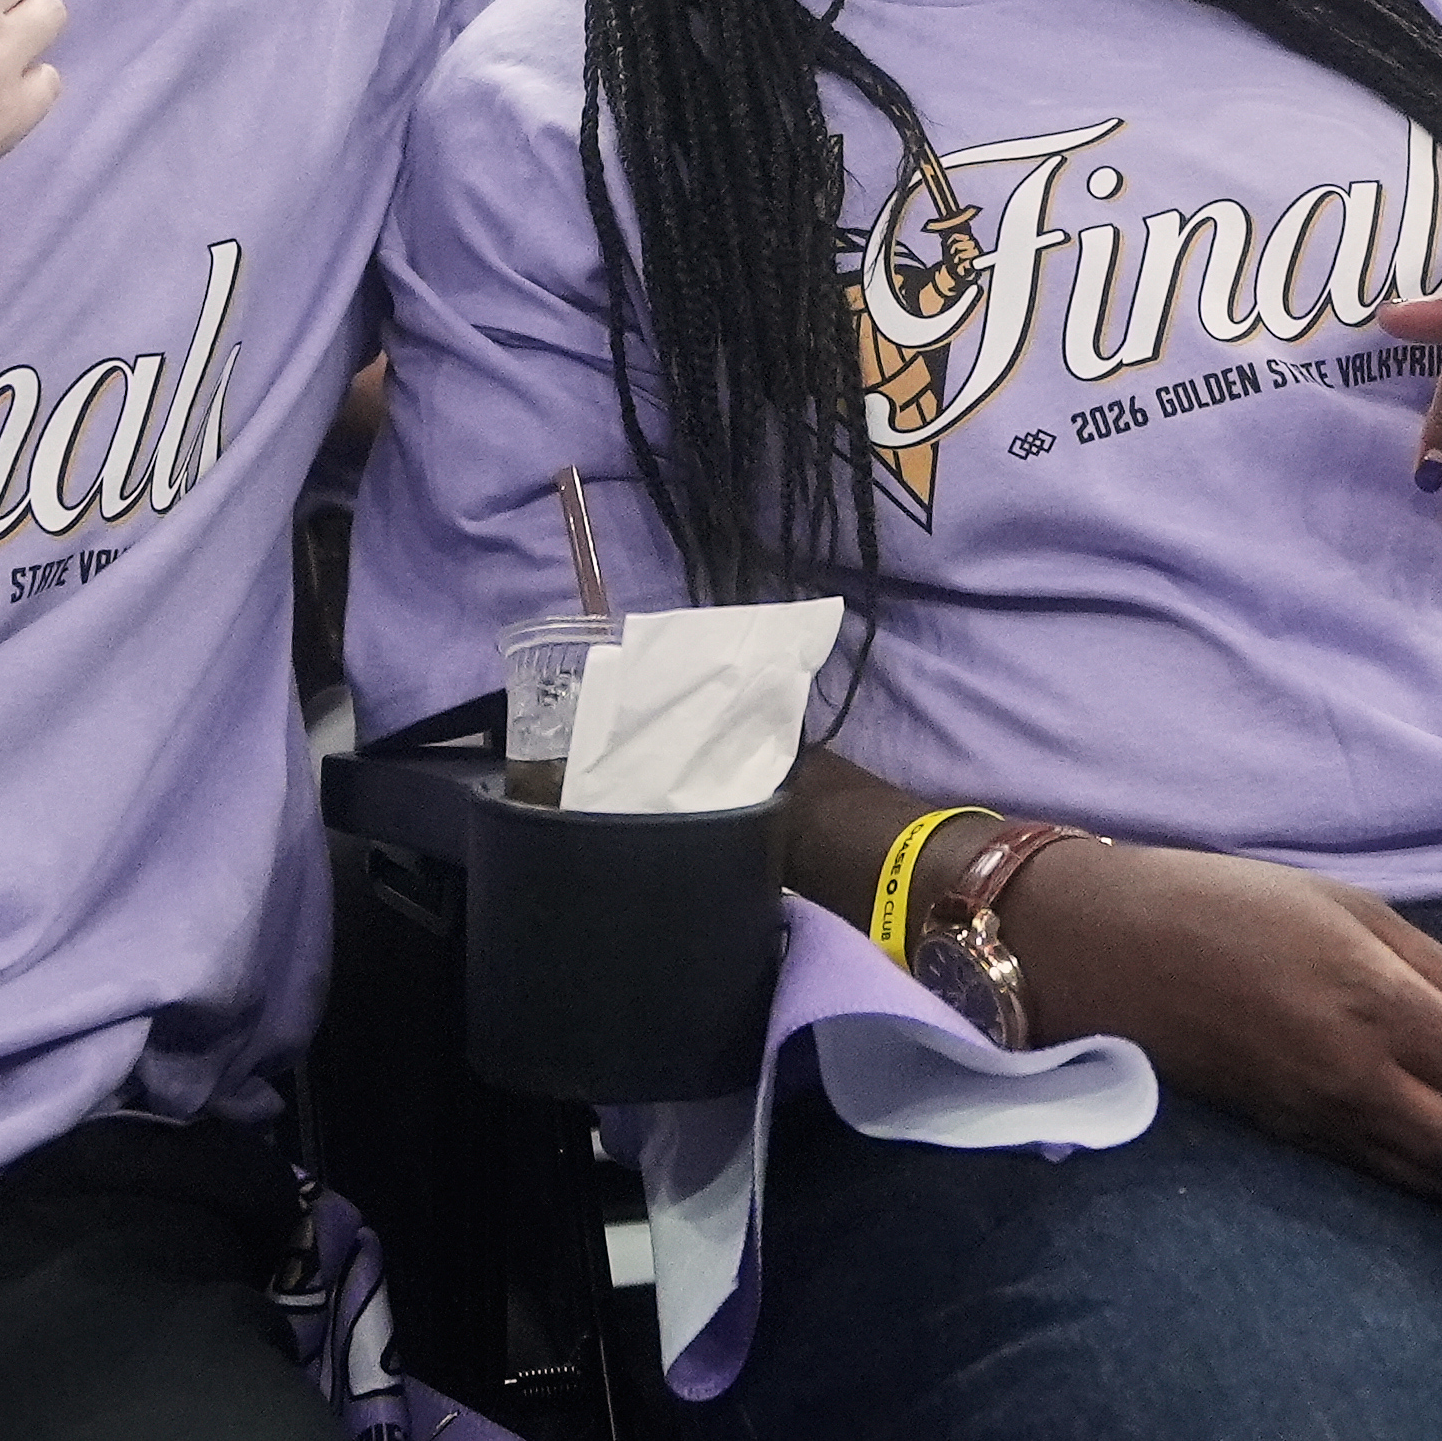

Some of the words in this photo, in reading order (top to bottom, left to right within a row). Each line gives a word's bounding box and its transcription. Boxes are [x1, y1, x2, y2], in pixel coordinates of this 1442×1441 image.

[1071, 395, 1150, 445] 2026
[1155, 362, 1263, 419] GOLDEN
[890, 823, 925, 876] CHASE
[880, 900, 895, 942] CLUB
